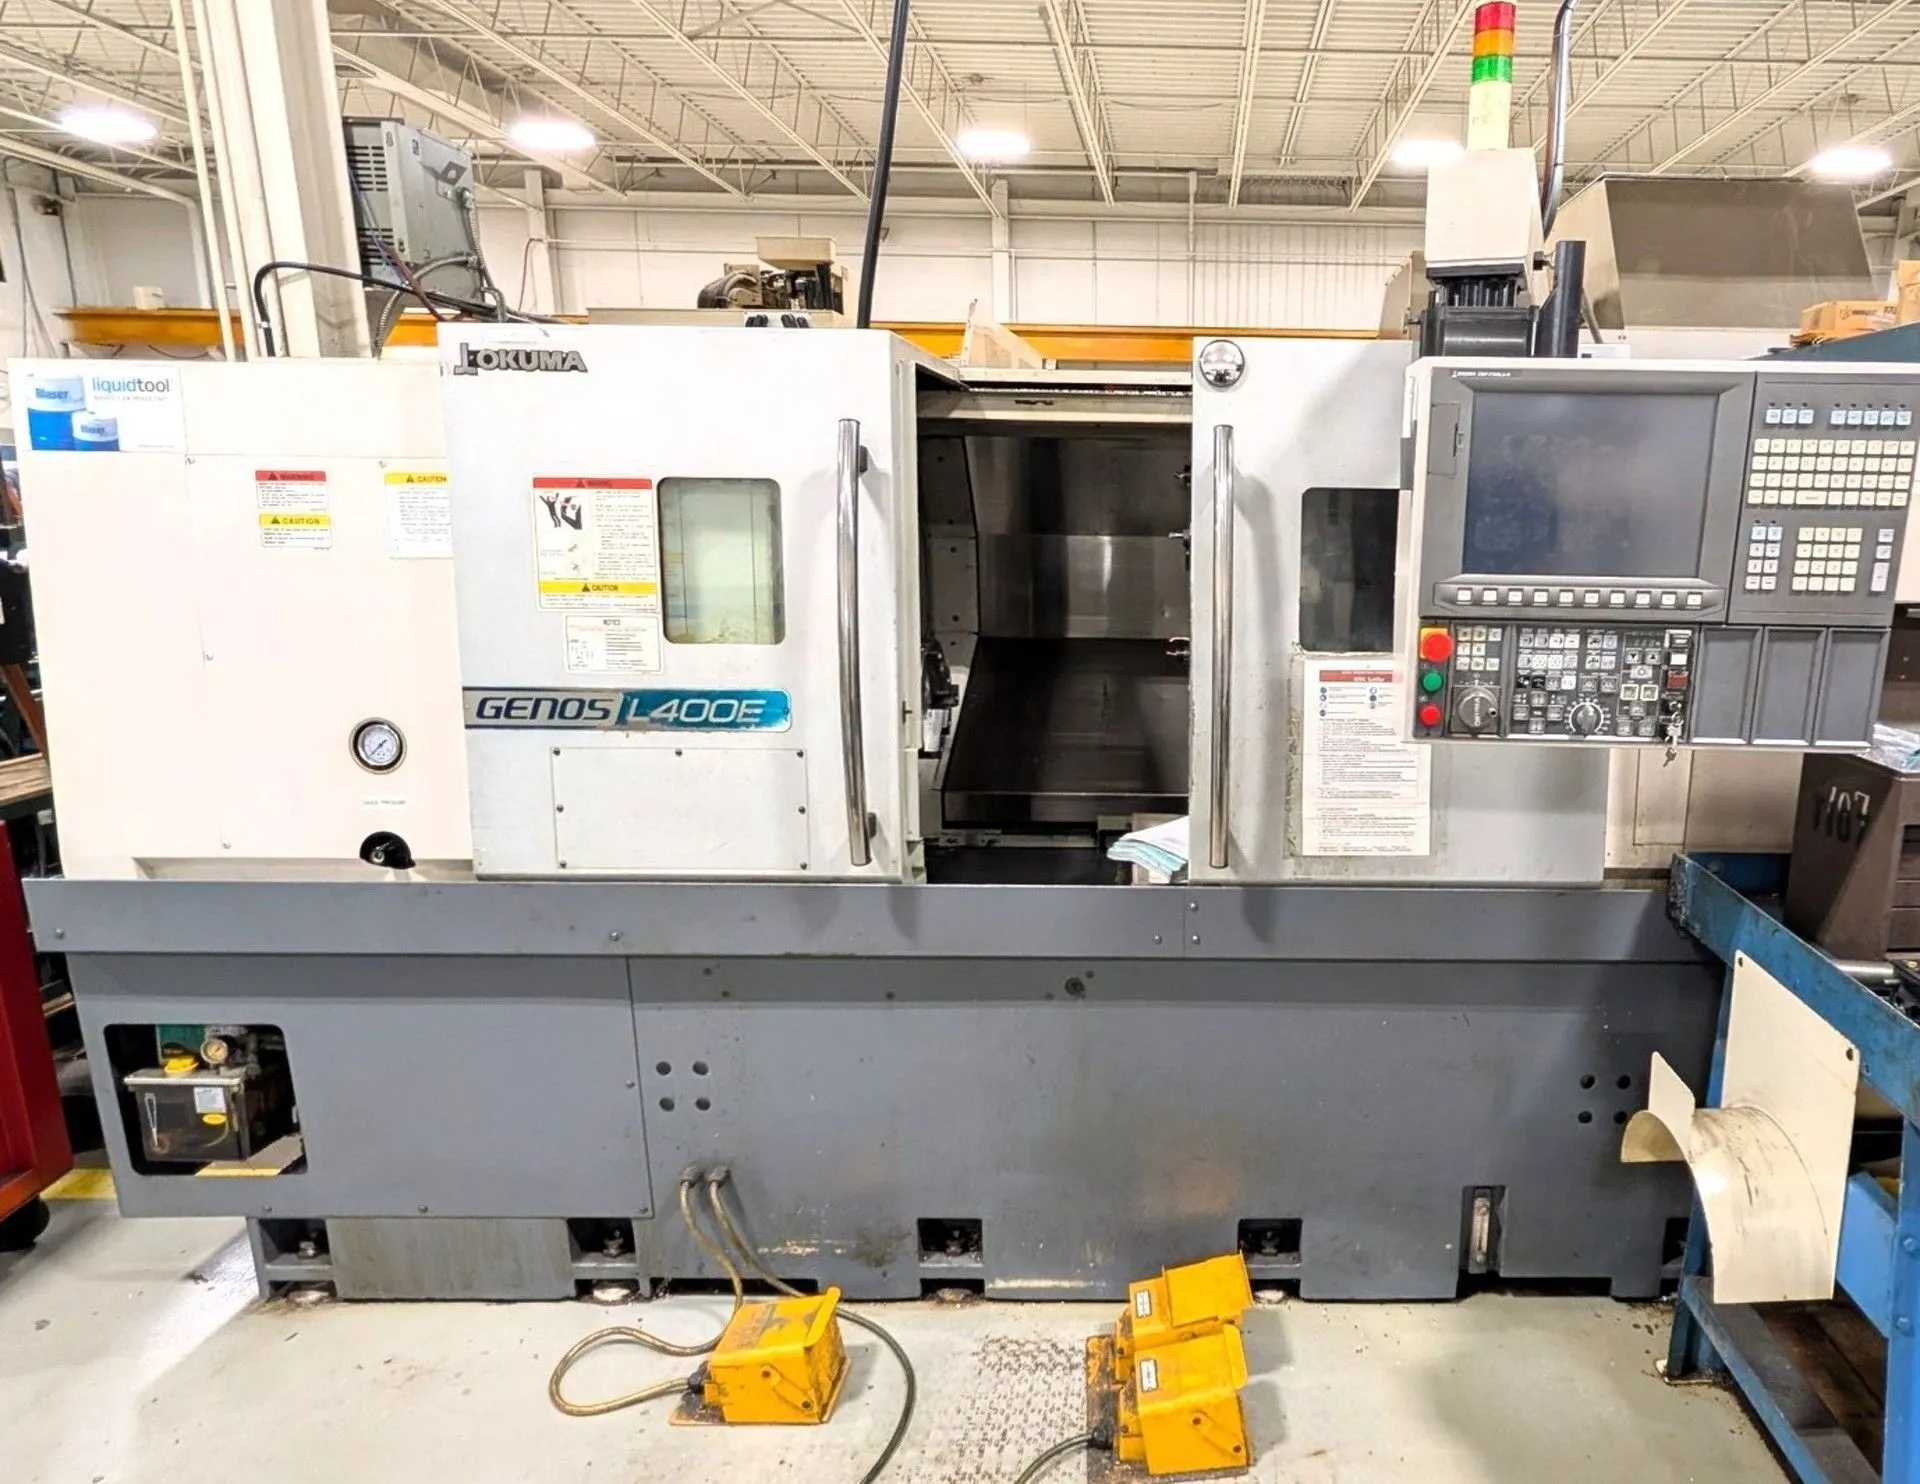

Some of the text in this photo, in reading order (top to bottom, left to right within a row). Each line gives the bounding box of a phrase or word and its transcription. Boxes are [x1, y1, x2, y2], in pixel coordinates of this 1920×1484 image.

[476, 348, 588, 373] OKUMA
[92, 376, 170, 393] liquidtool
[475, 696, 768, 723] GENOS L400E
